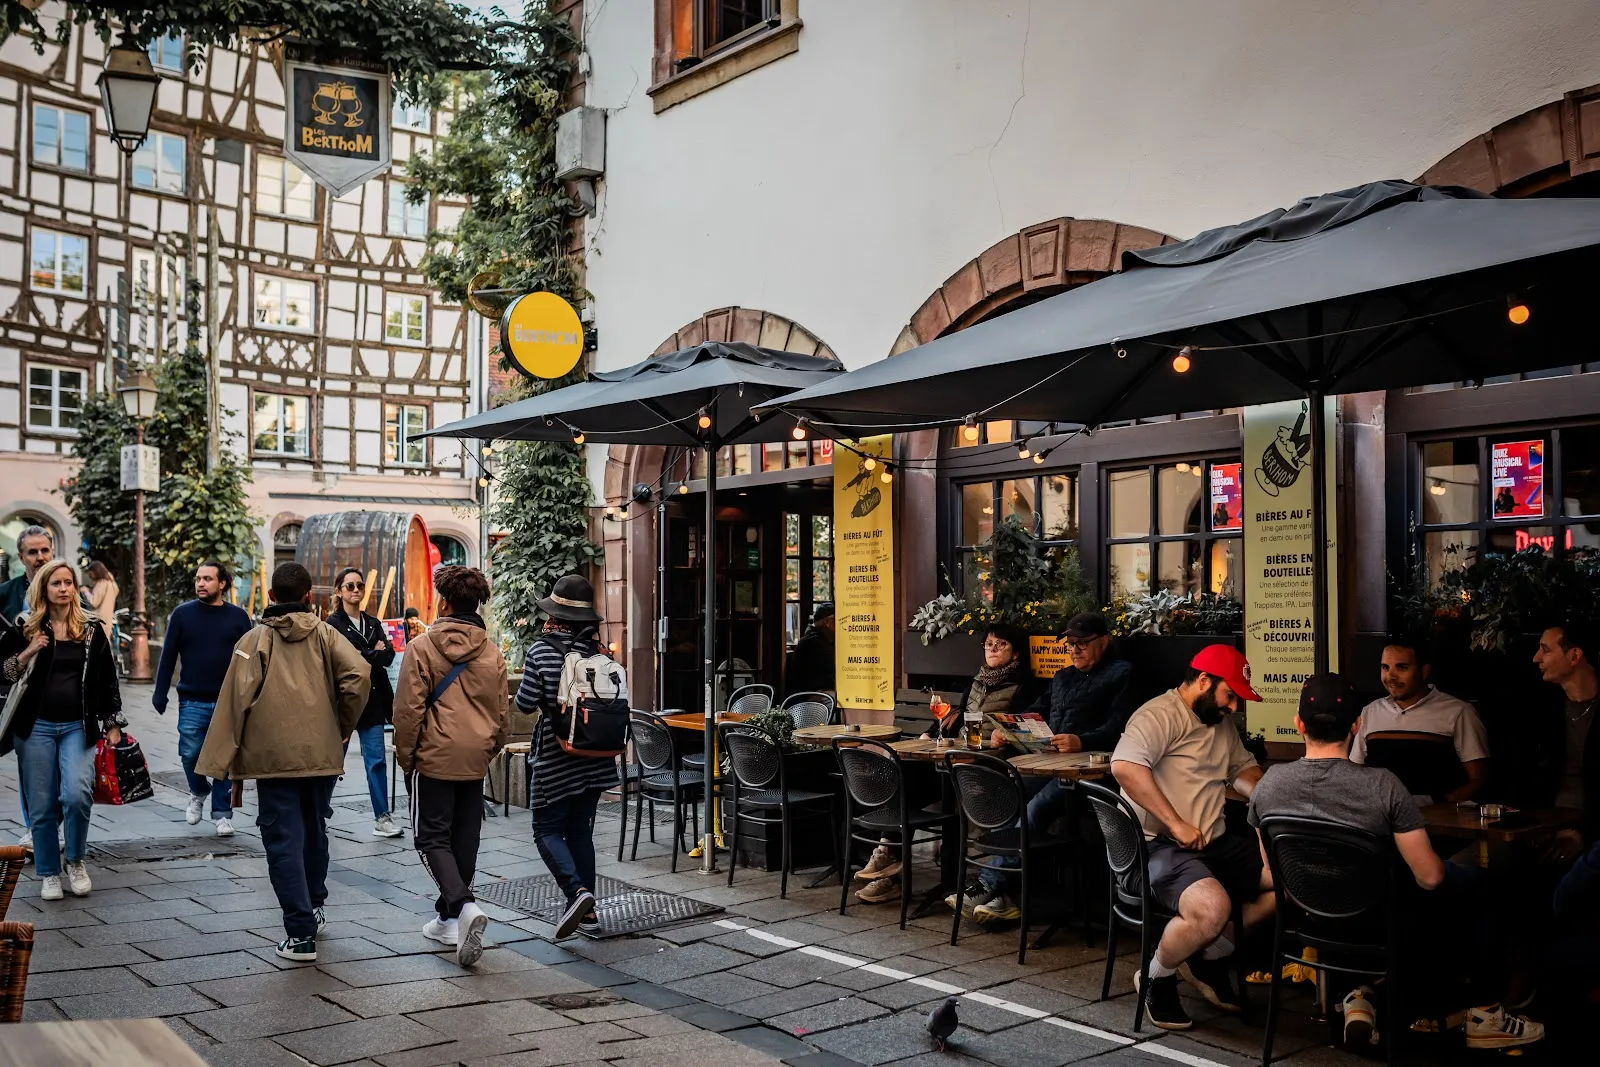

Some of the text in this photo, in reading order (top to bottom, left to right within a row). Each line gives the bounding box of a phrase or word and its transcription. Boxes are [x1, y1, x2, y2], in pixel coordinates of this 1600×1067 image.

[1494, 448, 1508, 458] QUIZ
[1264, 448, 1294, 485] BERTHOM
[1494, 457, 1522, 468] MUSICAL
[1494, 468, 1508, 477] LIVE
[1256, 510, 1287, 522] BIÈRES
[1290, 510, 1303, 520] AU
[1274, 524, 1298, 532] gamme
[844, 531, 862, 540] BIÈRES
[872, 529, 882, 538] FÛT
[1266, 553, 1313, 564] BIÈRES EN
[850, 564, 878, 573] BIÈRES EN
[848, 574, 879, 583] BOUTEILLES
[1272, 580, 1300, 588] sélection
[1300, 579, 1308, 587] de
[1264, 590, 1312, 599] bières préférées
[852, 614, 870, 622] BIÈRES
[872, 613, 876, 622] À
[1269, 617, 1312, 628] BIÈRES À
[848, 624, 880, 632] DÉCOUVRIR
[1032, 646, 1050, 654] HAPPY
[1265, 645, 1288, 653] Chaque
[848, 656, 880, 664] MAIS AUSSI
[1264, 674, 1288, 683] MAIS
[1261, 696, 1287, 704] oissons
[1276, 728, 1300, 736] BERTH
